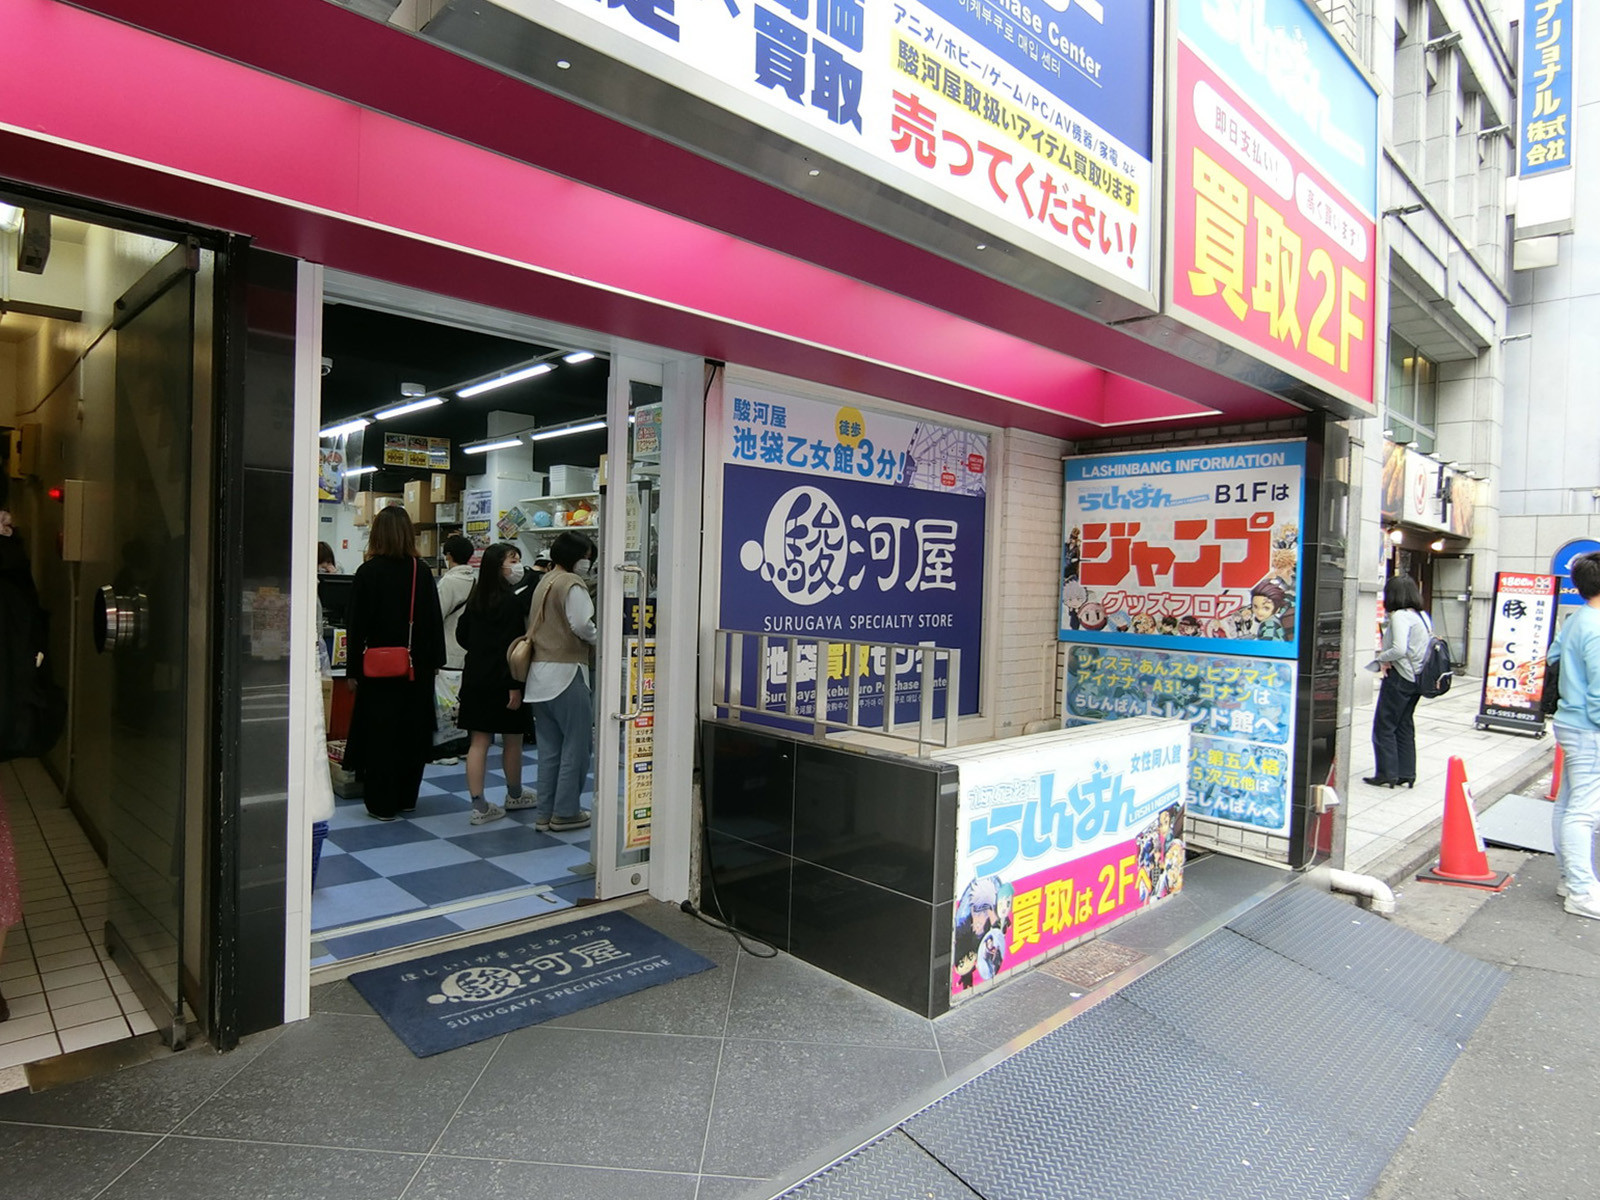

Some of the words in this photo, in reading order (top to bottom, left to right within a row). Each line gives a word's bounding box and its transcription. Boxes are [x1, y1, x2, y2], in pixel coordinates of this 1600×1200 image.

[754, 3, 863, 136] 買取
[1048, 22, 1102, 78] Center
[897, 38, 1136, 207] 駿河屋取扱いアイテム買取ります
[1187, 146, 1367, 374] 買取2F
[733, 397, 787, 429] 駿河屋
[839, 419, 862, 438] 徒歩
[1082, 460, 1171, 478] LASHINBANG
[1176, 452, 1285, 471] INFORMATION
[1215, 482, 1289, 504] B1Fは
[740, 485, 958, 605] 駿河屋
[1080, 512, 1275, 589] ジャンプ
[763, 615, 842, 632] SURUGAYA
[849, 614, 914, 630] SPECIALTY
[918, 613, 953, 628] STORE
[1102, 590, 1244, 618] グッズフロア
[1130, 745, 1181, 774] 女性同人館
[968, 761, 1136, 878] らしんばん
[1009, 854, 1152, 954] 買取は2Fへ
[426, 939, 632, 1004] 駿河屋
[446, 998, 541, 1029] SURUGAYA
[545, 973, 624, 1001] SPECIALTY
[627, 958, 672, 977] STORE
